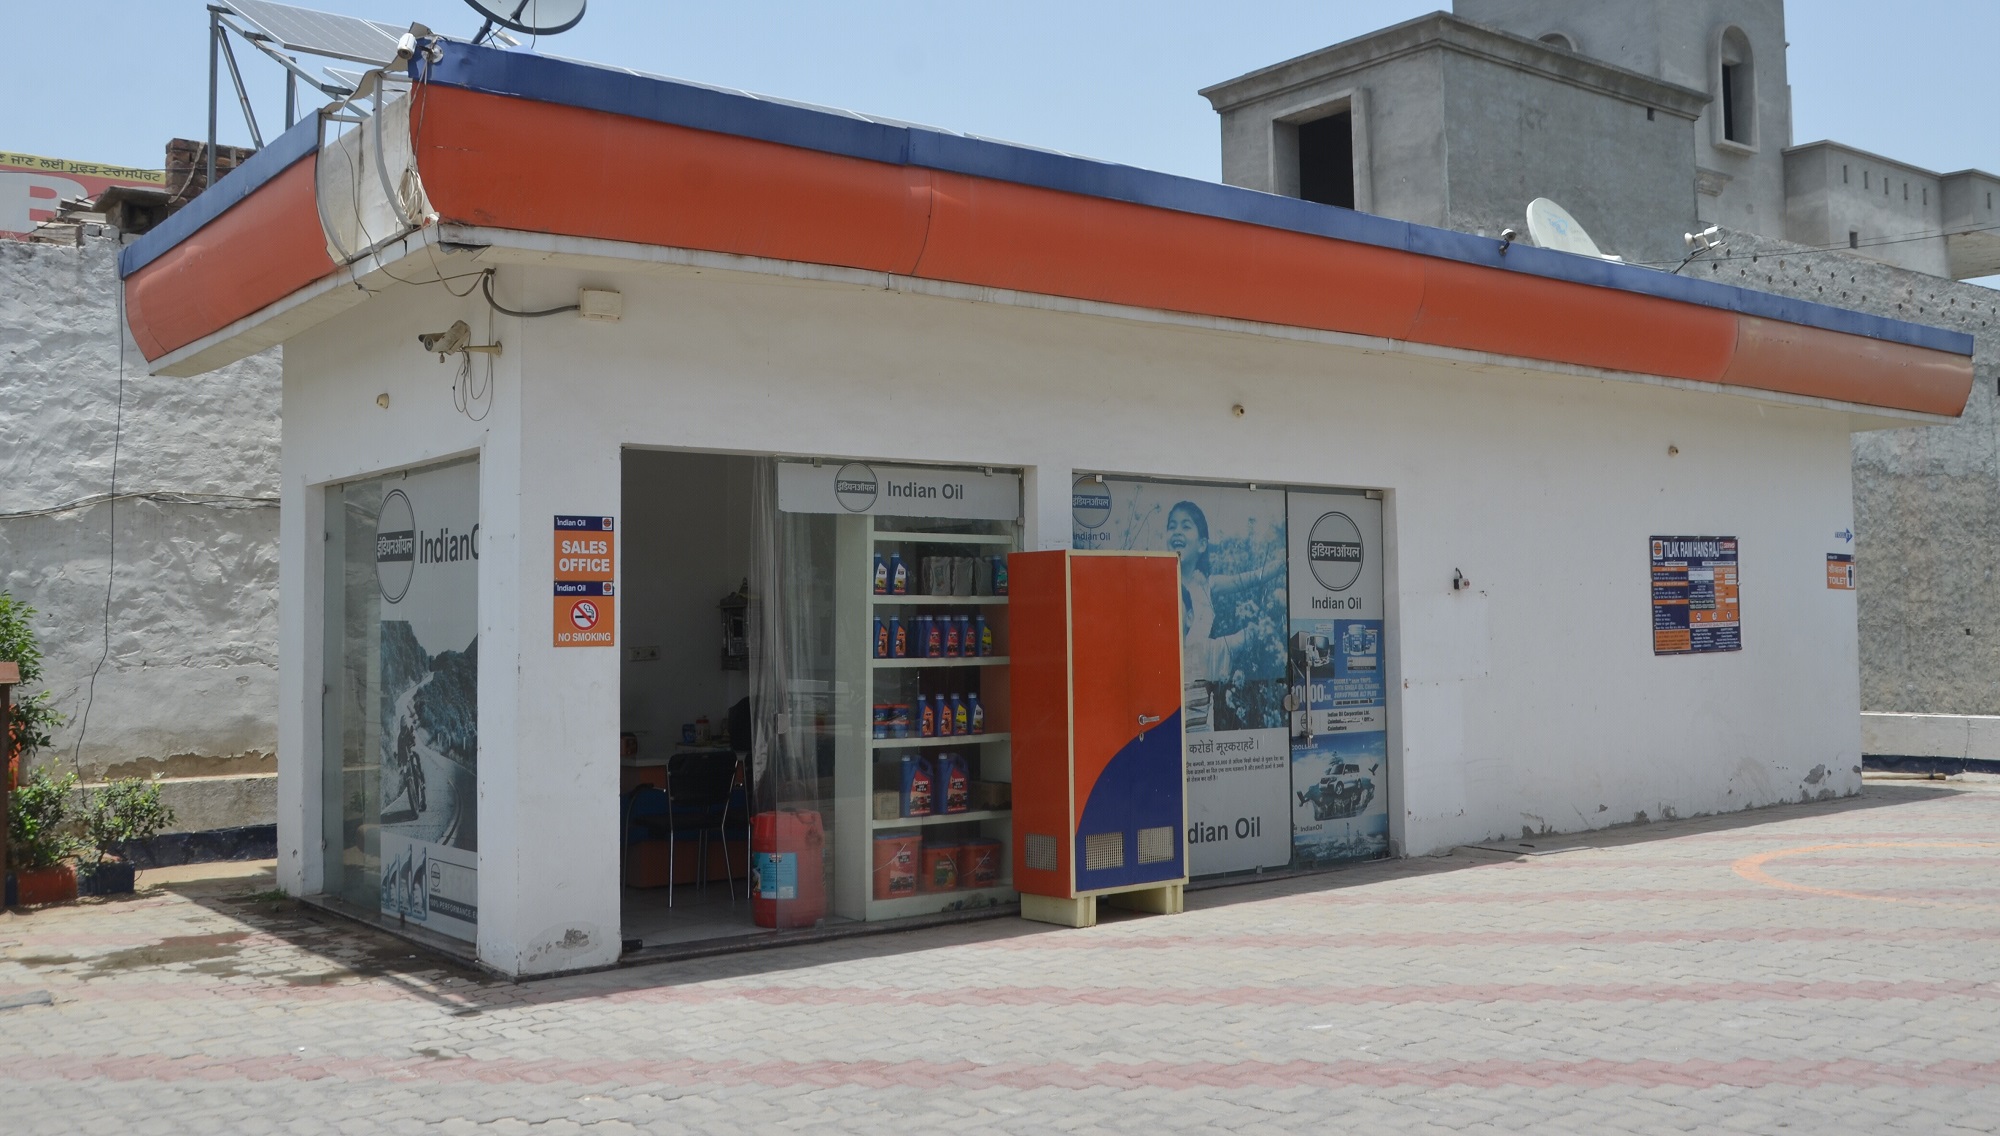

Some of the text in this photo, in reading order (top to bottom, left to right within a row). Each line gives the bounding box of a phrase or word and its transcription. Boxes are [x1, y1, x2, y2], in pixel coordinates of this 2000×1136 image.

[838, 480, 875, 493] इंडियनऑयल
[887, 481, 963, 500] Indian Oil
[557, 519, 586, 527] Indian Oil
[1073, 532, 1111, 541] Indian Oil
[376, 535, 413, 560] इंडियनऑयल
[561, 540, 607, 555] SALES
[1311, 541, 1360, 559] इंडियनऑयल
[559, 557, 610, 572] OFFICE
[557, 584, 586, 592] Indian Oil
[1829, 577, 1846, 585] TOILET
[1311, 597, 1362, 611] Indian Oil
[558, 632, 611, 642] NO SMOKING
[1187, 816, 1261, 844] dian Oil
